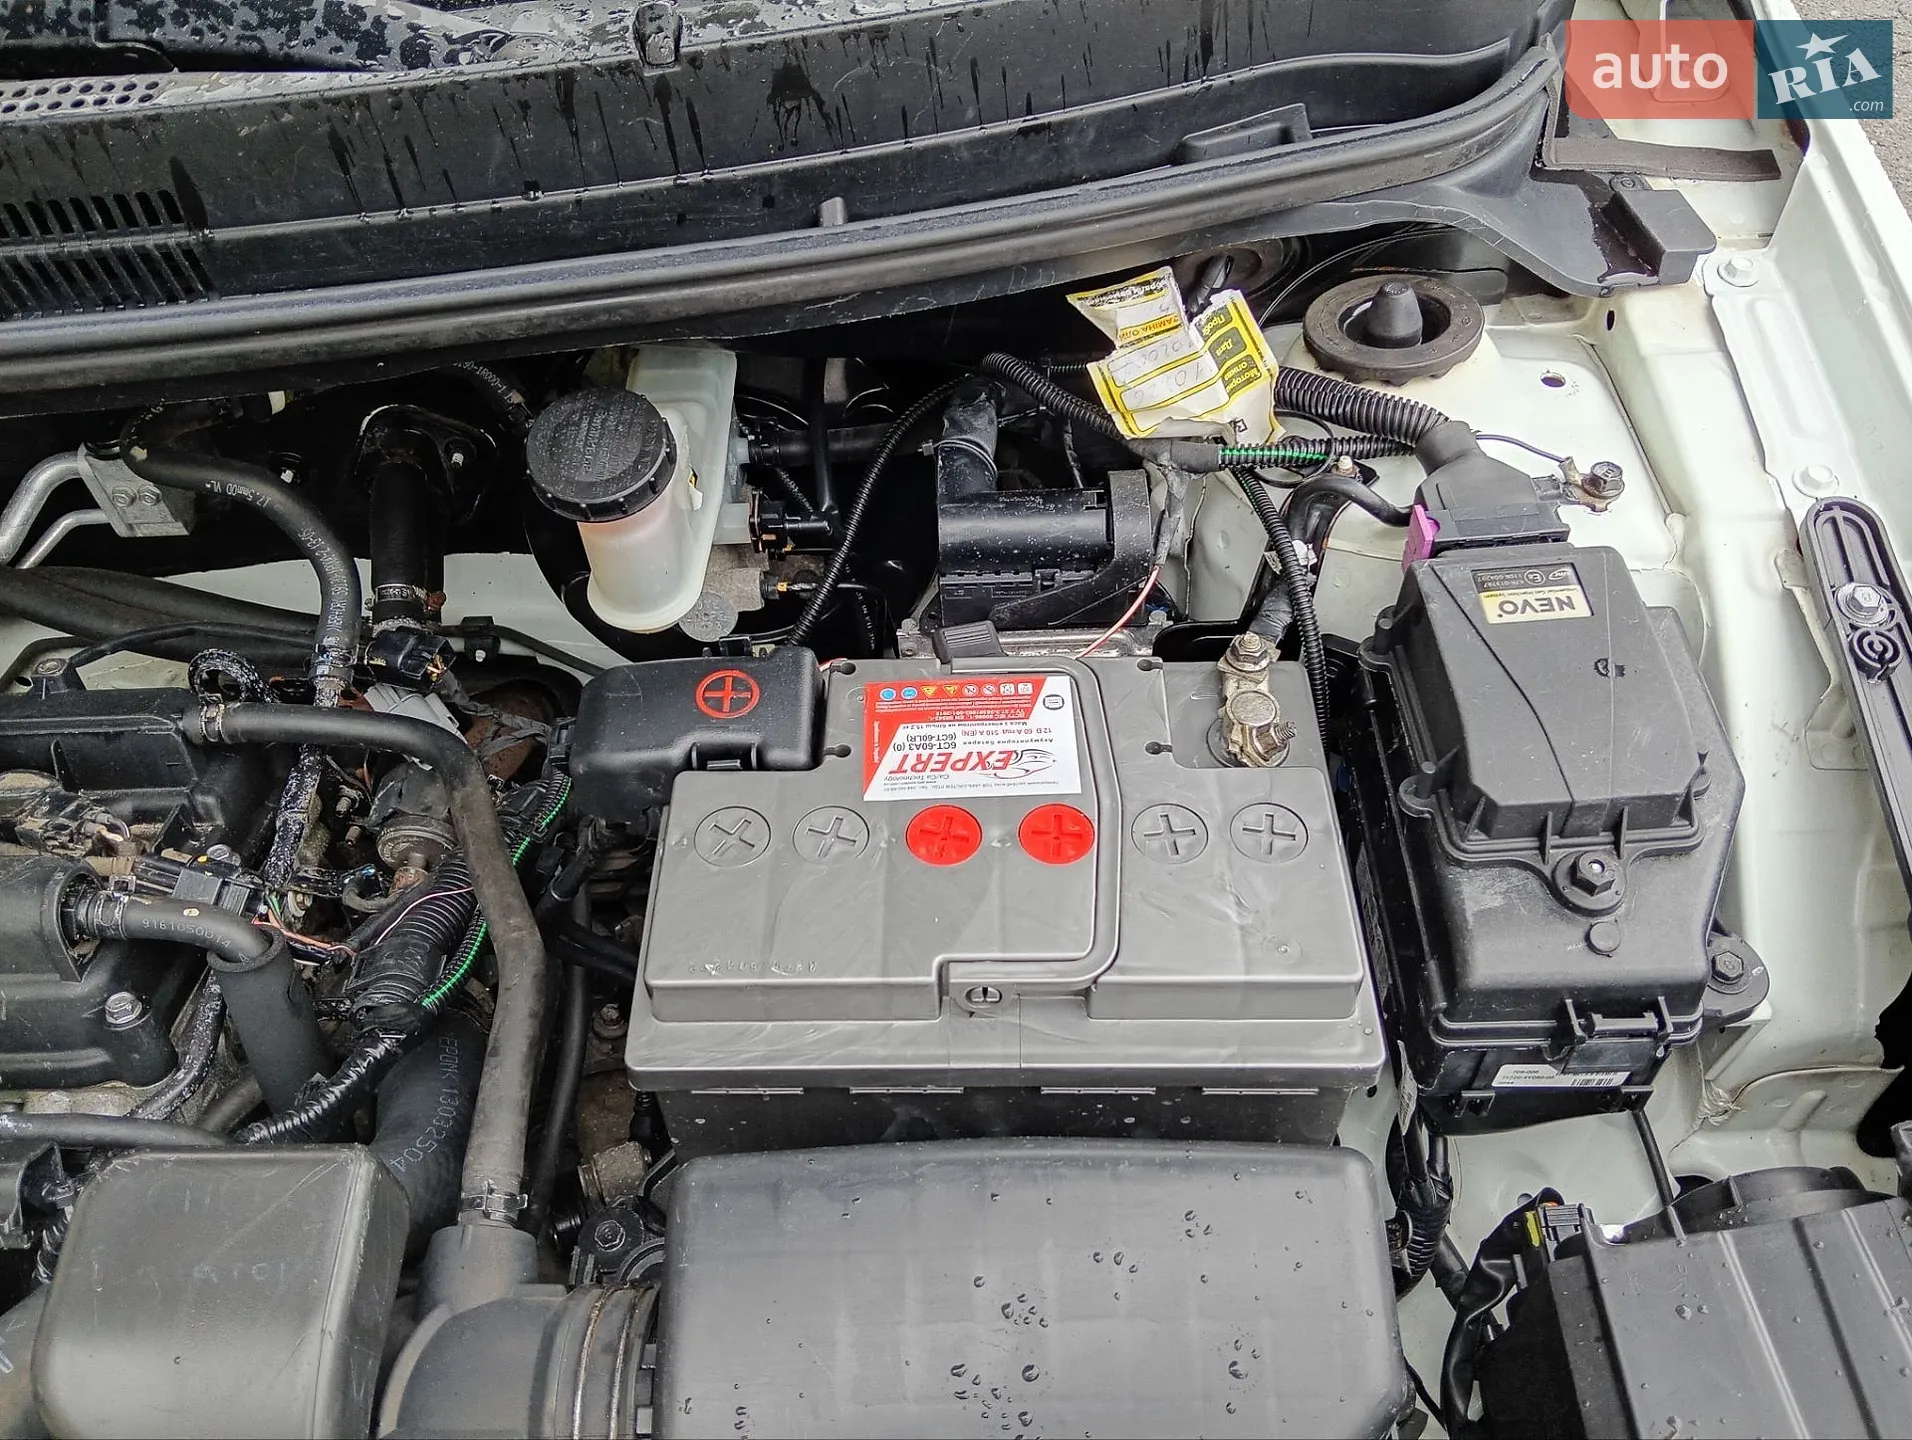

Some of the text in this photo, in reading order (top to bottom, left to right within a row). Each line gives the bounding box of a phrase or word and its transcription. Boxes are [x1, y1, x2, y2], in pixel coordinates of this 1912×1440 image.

[1500, 596, 1575, 616] NEVO
[961, 729, 977, 737] (EN)
[889, 750, 1015, 774] EXPERT
[884, 774, 924, 782] Technology
